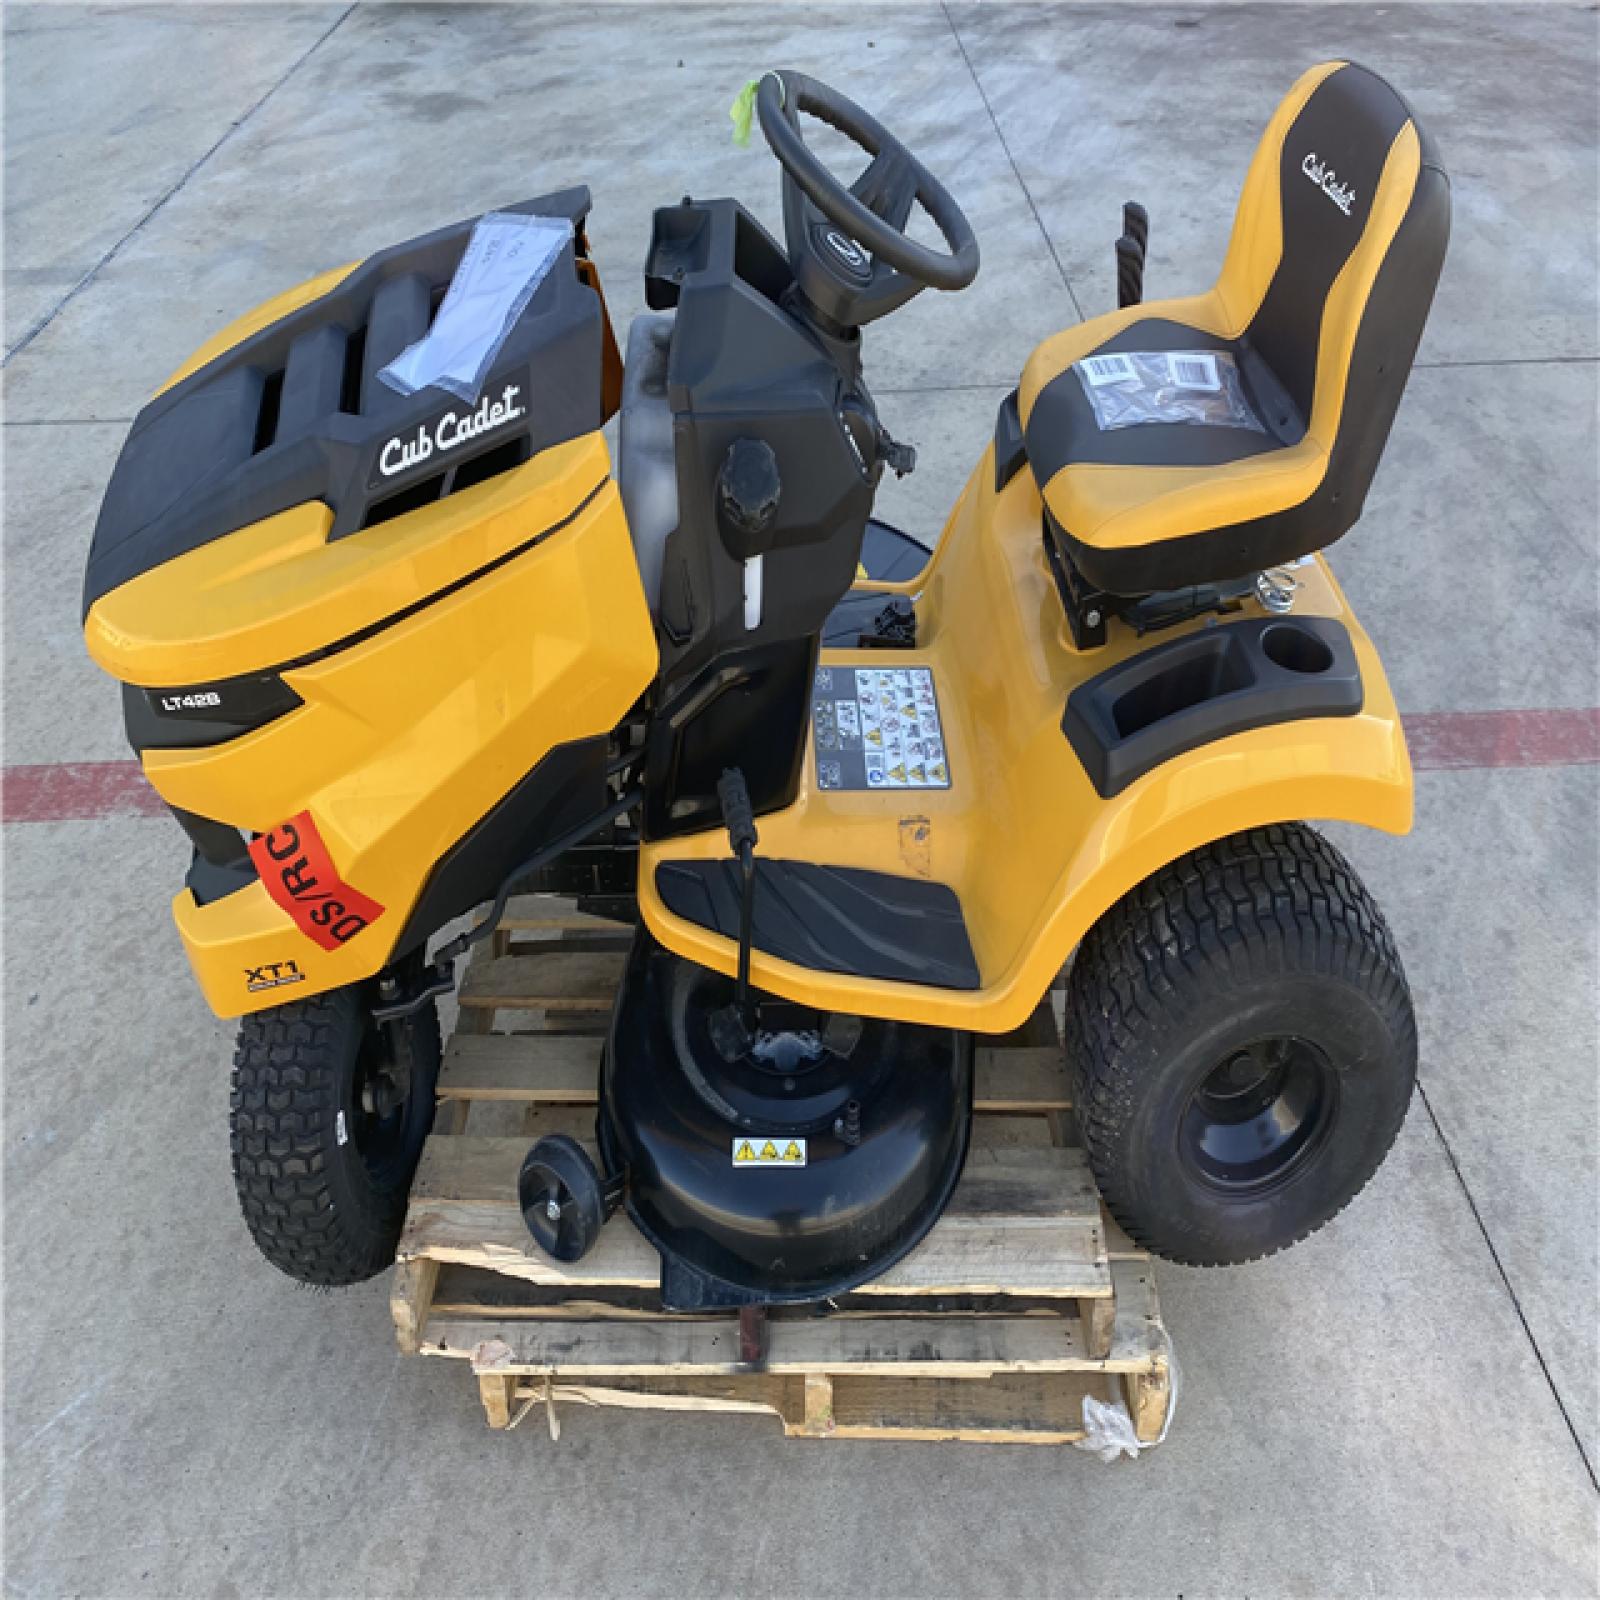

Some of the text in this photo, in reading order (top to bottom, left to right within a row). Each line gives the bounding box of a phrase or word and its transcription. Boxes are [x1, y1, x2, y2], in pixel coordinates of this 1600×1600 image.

[379, 384, 521, 476] Cub Cadet
[265, 824, 368, 943] DS/RC
[244, 960, 298, 983] XT1
